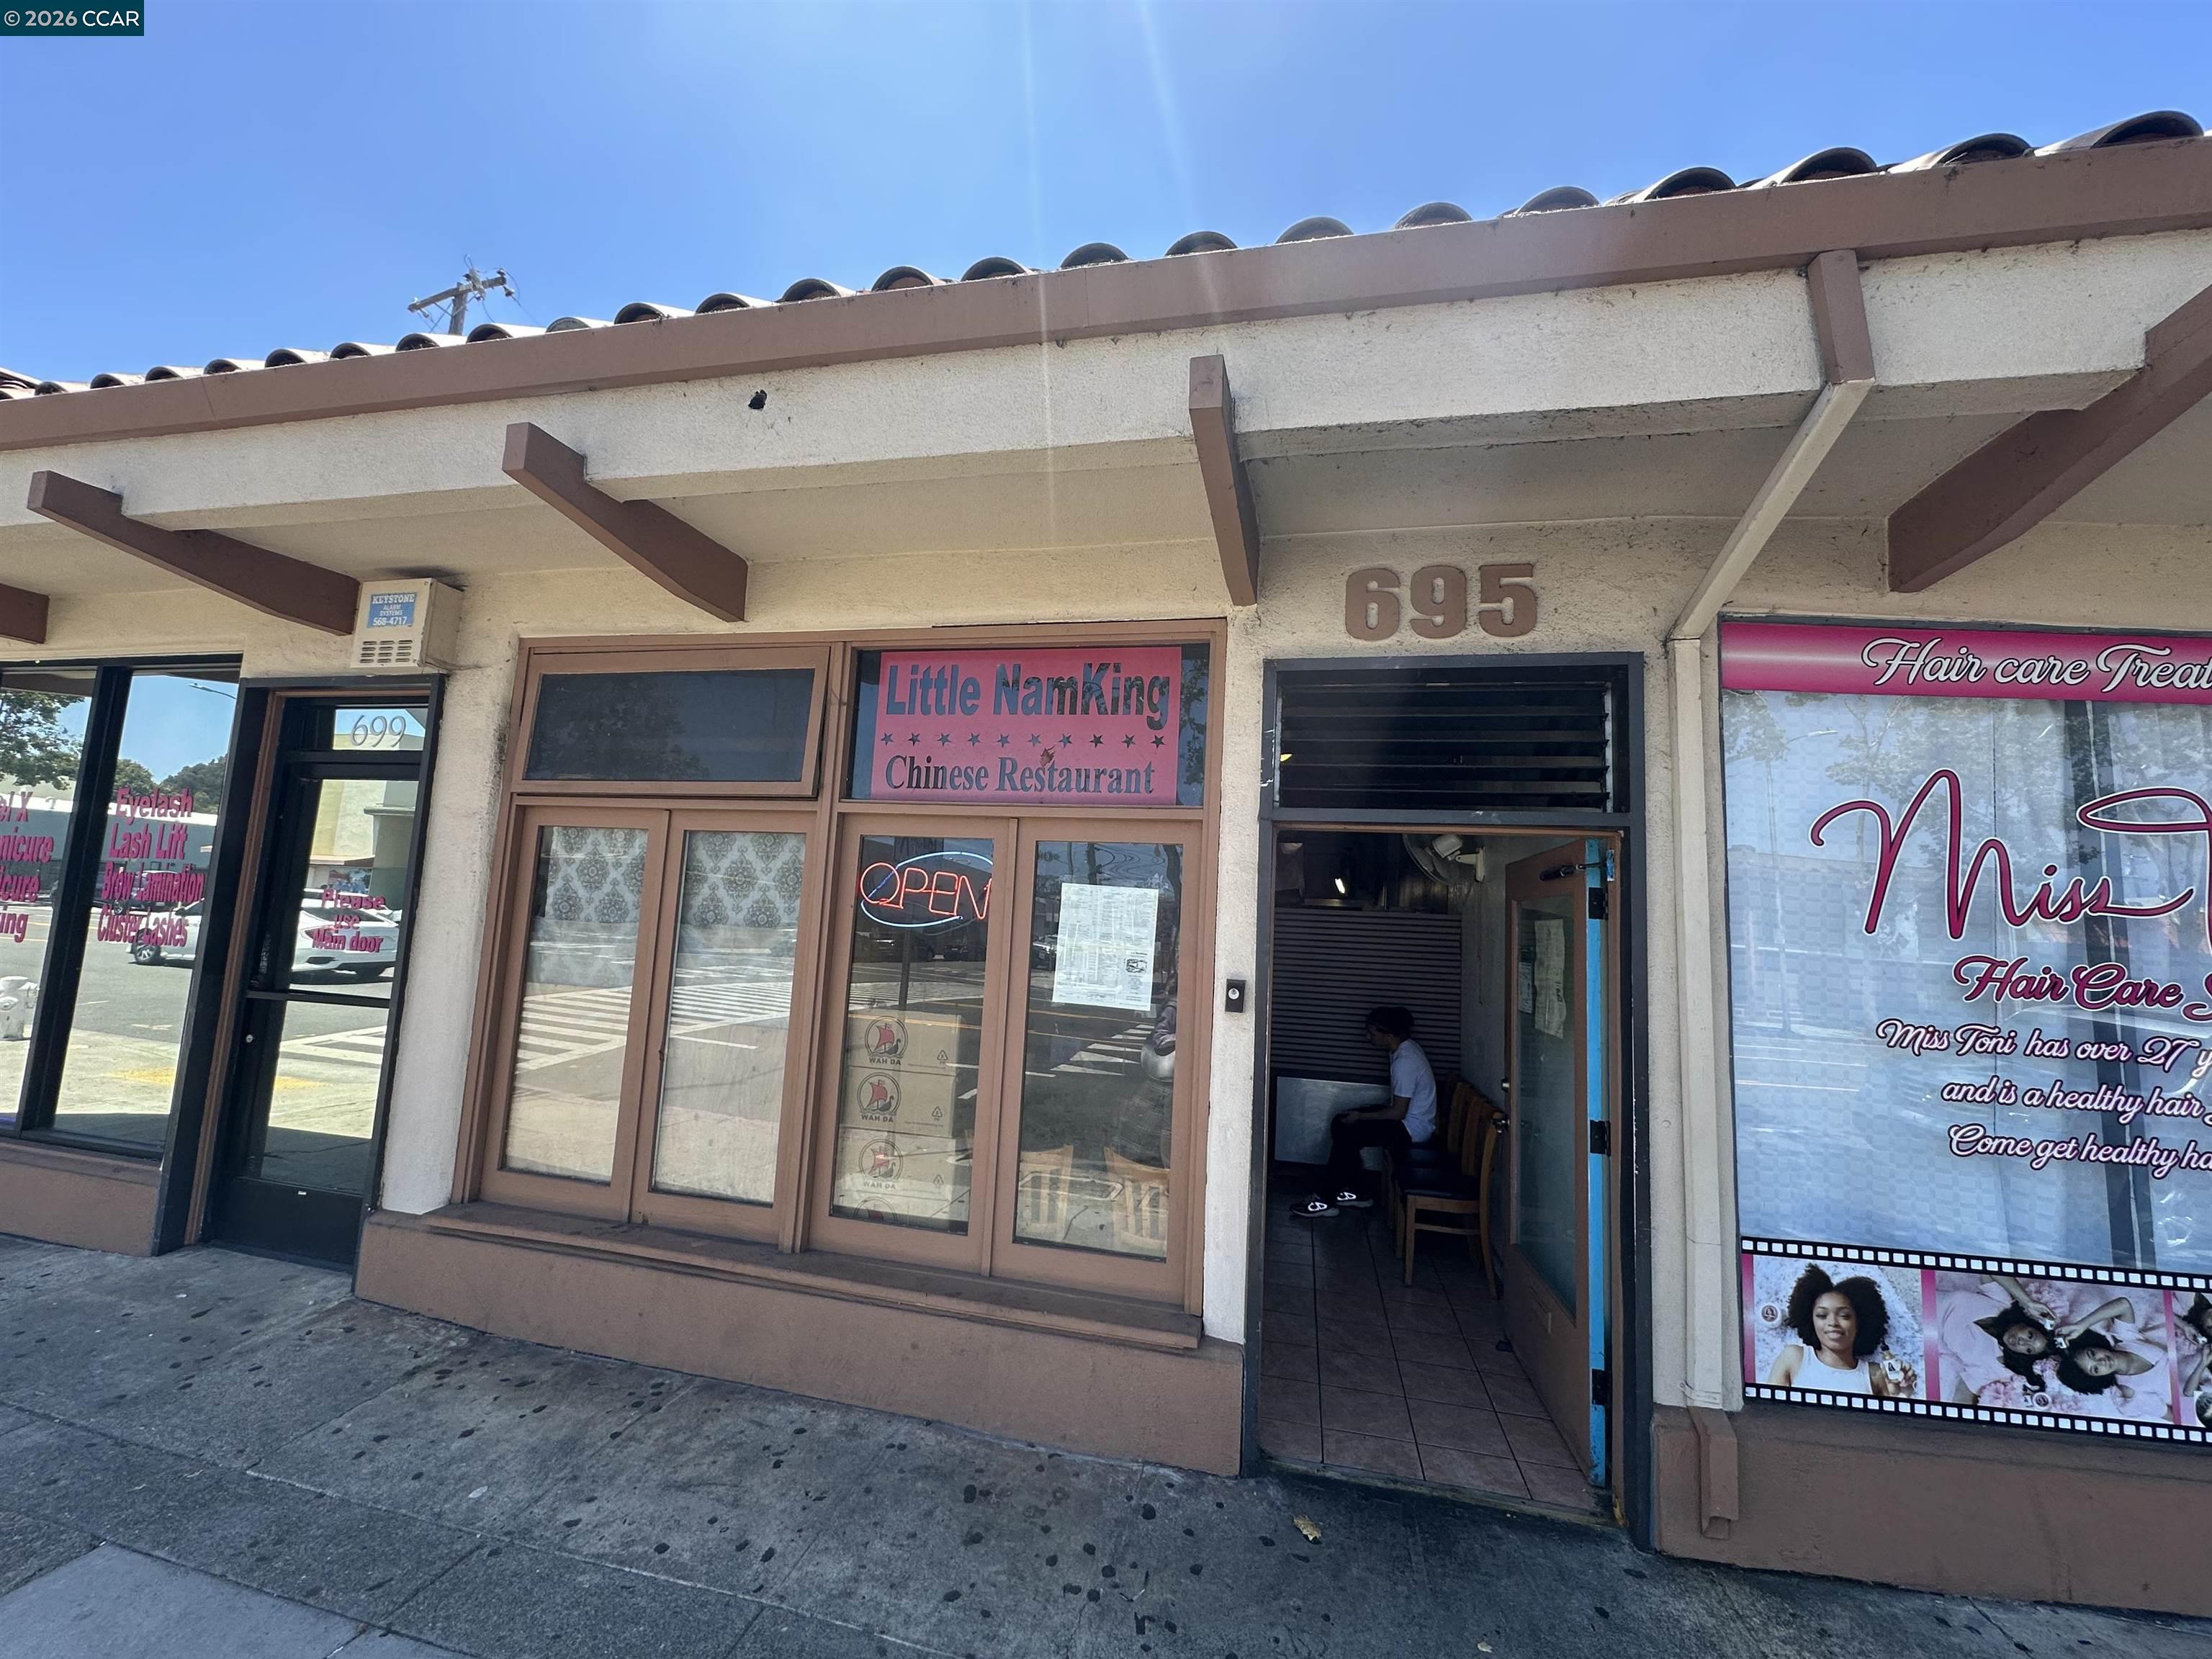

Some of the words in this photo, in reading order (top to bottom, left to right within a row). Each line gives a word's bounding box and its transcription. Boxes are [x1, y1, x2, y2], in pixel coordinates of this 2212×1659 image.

[372, 594, 415, 603] KEYSTONE
[1345, 564, 1537, 641] 695
[1861, 637, 1986, 685] Hair
[1994, 655, 2090, 685] care
[886, 664, 981, 716] Little
[993, 662, 1171, 731] NamKing
[350, 715, 406, 748] 699
[886, 754, 989, 791] Chinese
[994, 756, 1156, 793] Restaurant
[16, 791, 33, 822] X
[116, 787, 194, 826] Eyelash
[109, 823, 152, 859] Lash
[155, 824, 188, 860] Lift
[1809, 768, 2195, 940] Miss
[102, 862, 135, 900] Brow
[135, 863, 205, 902] Lamination
[321, 889, 386, 910] Please
[860, 863, 992, 920] OPEN
[97, 904, 142, 943] Cluster
[143, 907, 189, 947] Lashes
[312, 929, 346, 950] Main
[350, 931, 384, 953] door
[334, 914, 361, 930] use
[1953, 954, 2069, 1002] Hair
[2071, 962, 2185, 1010] Care
[1876, 1018, 1950, 1056] Miss
[1955, 1023, 2018, 1056] Toni
[2024, 1026, 2069, 1061] has
[2074, 1041, 2132, 1062] over
[2137, 1038, 2200, 1071] 27
[1941, 1075, 1999, 1105] and
[1997, 1079, 2018, 1105] is
[2023, 1089, 2045, 1107] a
[2046, 1080, 2145, 1125] healthy
[2145, 1086, 2206, 1118] hair
[1948, 1123, 2032, 1157] Come
[2031, 1138, 2080, 1169] get
[2078, 1134, 2180, 1179] healthy
